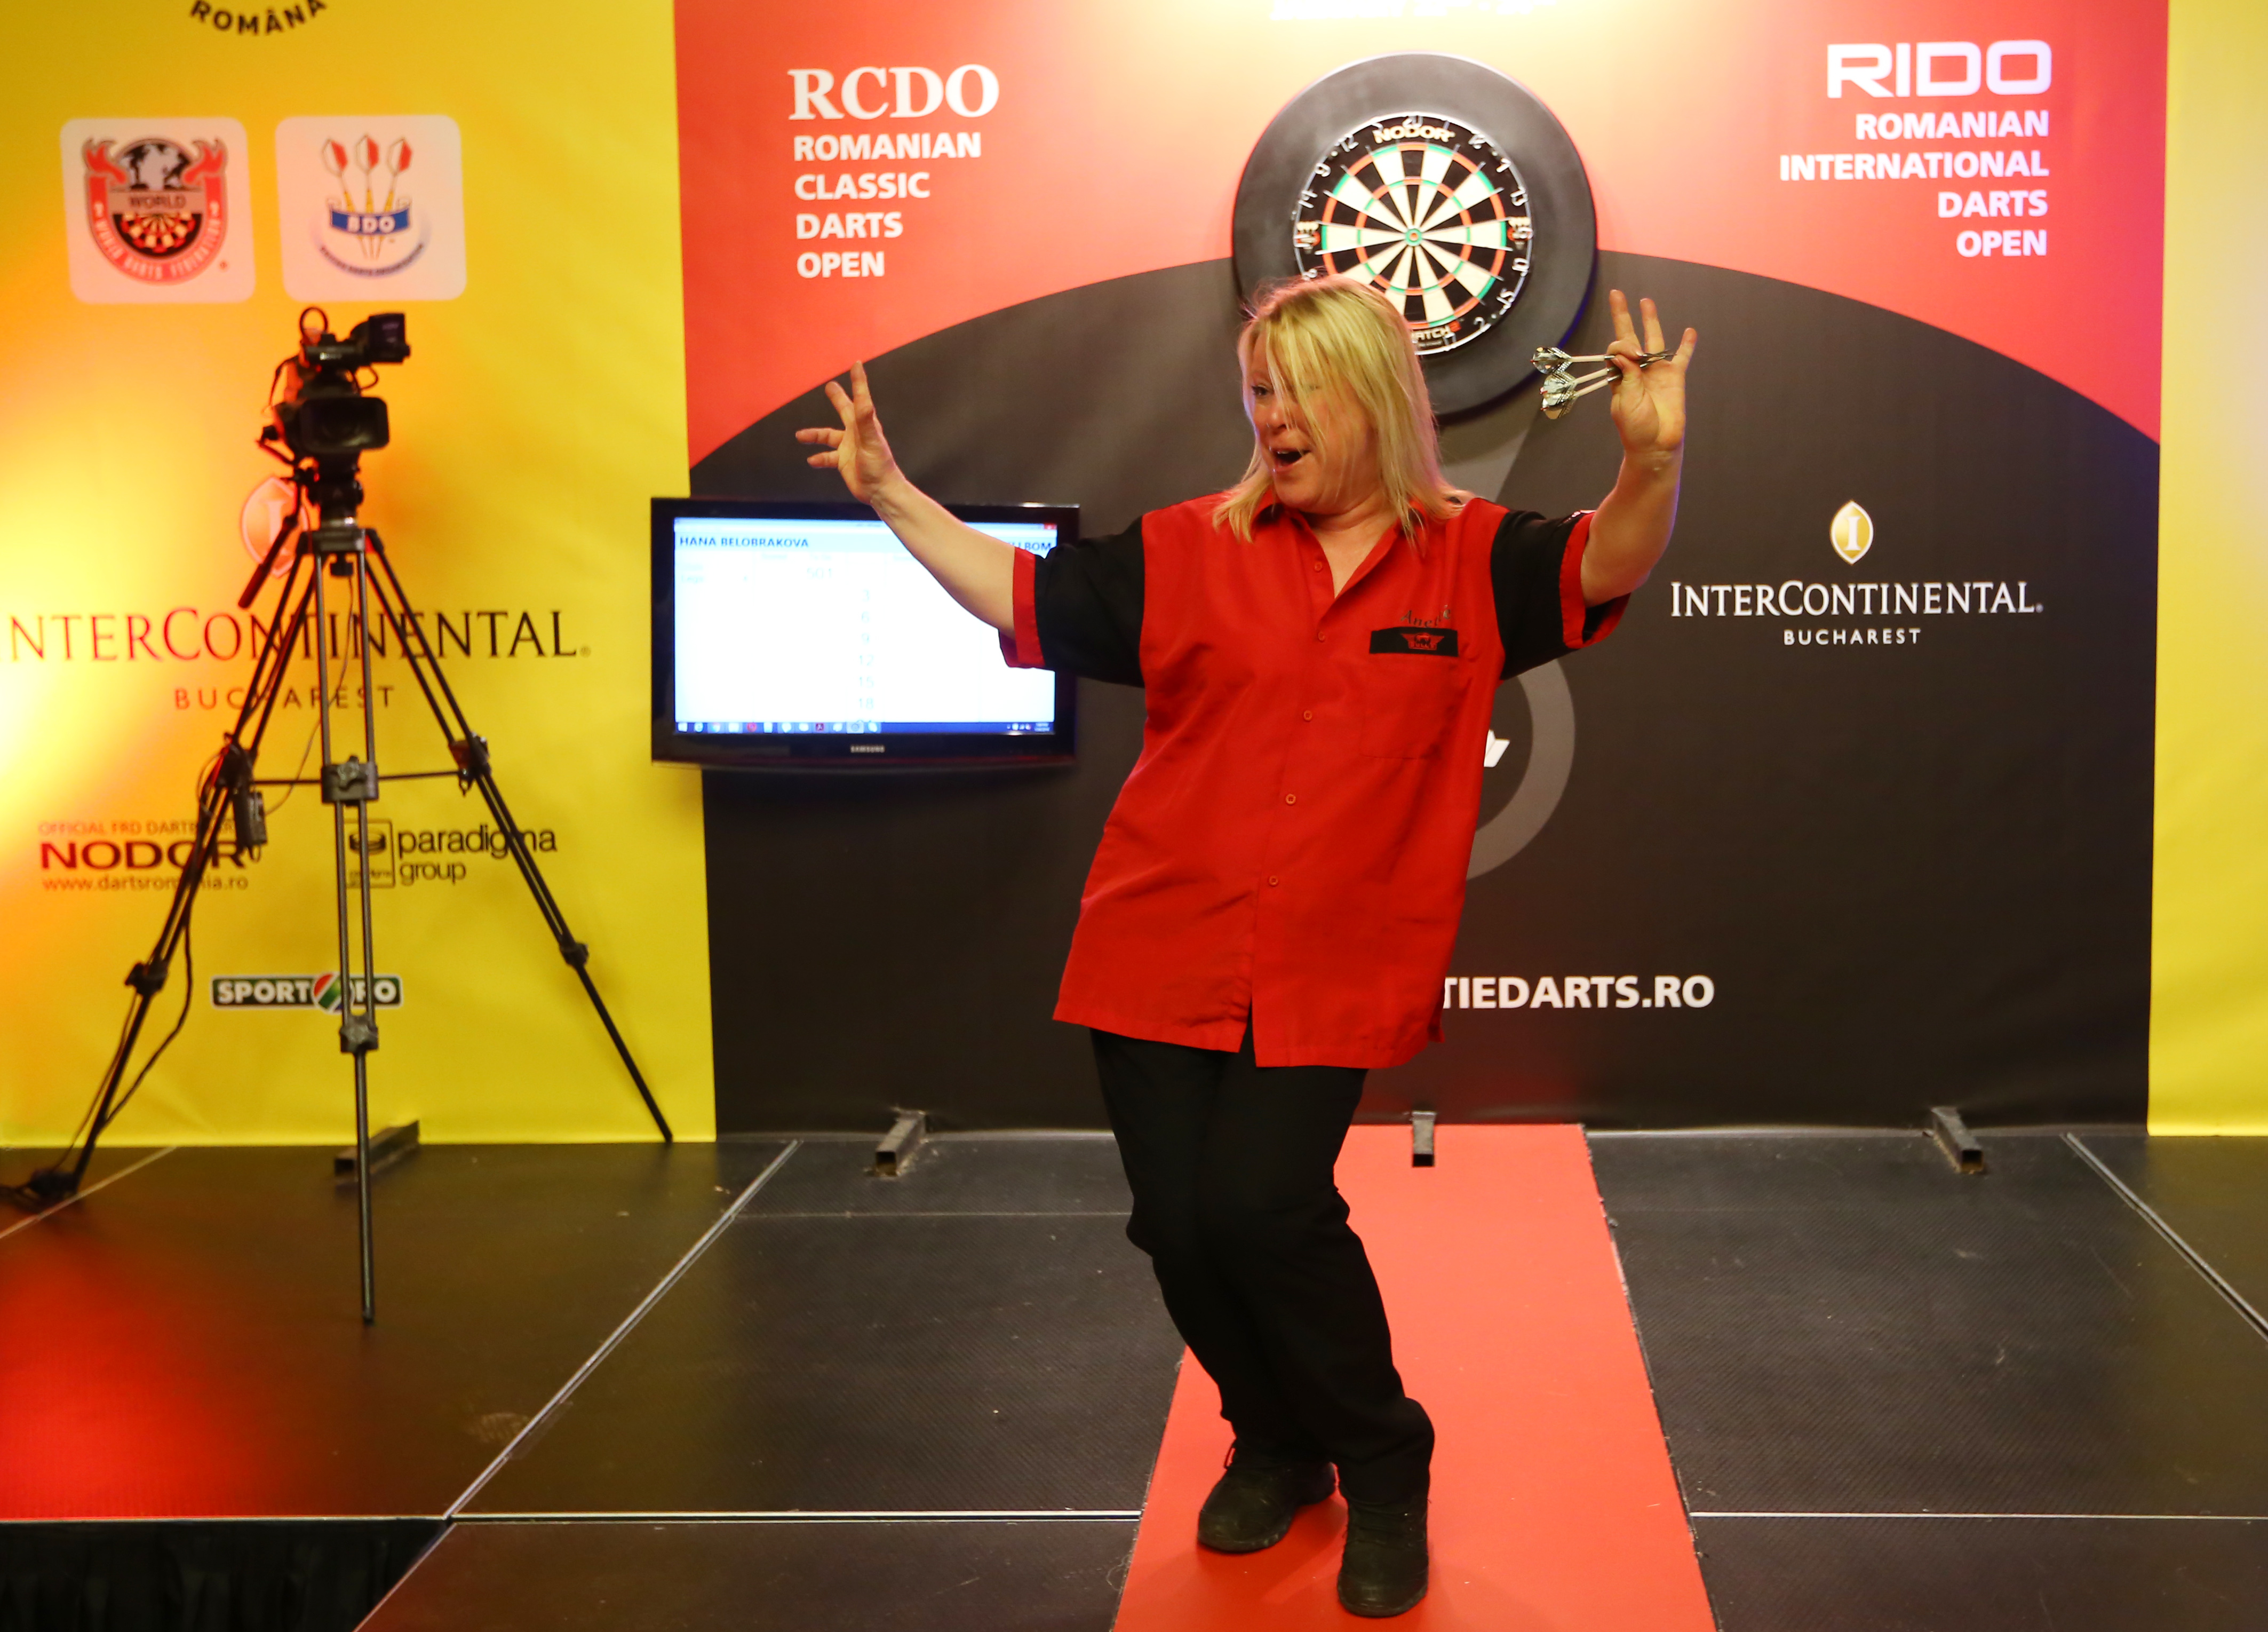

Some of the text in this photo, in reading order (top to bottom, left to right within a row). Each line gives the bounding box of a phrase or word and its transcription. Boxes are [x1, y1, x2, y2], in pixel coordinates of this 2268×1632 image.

[1827, 39, 2052, 98] RIDO
[787, 64, 1000, 120] RCDO
[1856, 110, 2049, 140] ROMANIAN
[794, 132, 982, 162] ROMANIAN
[1780, 150, 2050, 181] INTERNATIONAL
[794, 172, 930, 201] CLASSIC
[1938, 189, 2048, 218] DARTS
[348, 215, 396, 234] BDO
[796, 212, 904, 240] DARTS
[1956, 230, 2047, 258] OPEN
[797, 251, 885, 279] OPEN
[680, 536, 809, 548] HANA BELOBRAKOVA
[1670, 580, 2035, 618] INTERCONTINENTAL
[7, 606, 577, 662] NTERCONTINENTAL
[1783, 628, 1921, 646] BUCHAREST
[174, 685, 394, 710] BUCAREST
[38, 820, 105, 836] OFFICIAL
[399, 861, 467, 886] group
[217, 979, 311, 1004] SPORT
[1442, 975, 1715, 1009] TIEDARTS.RO
